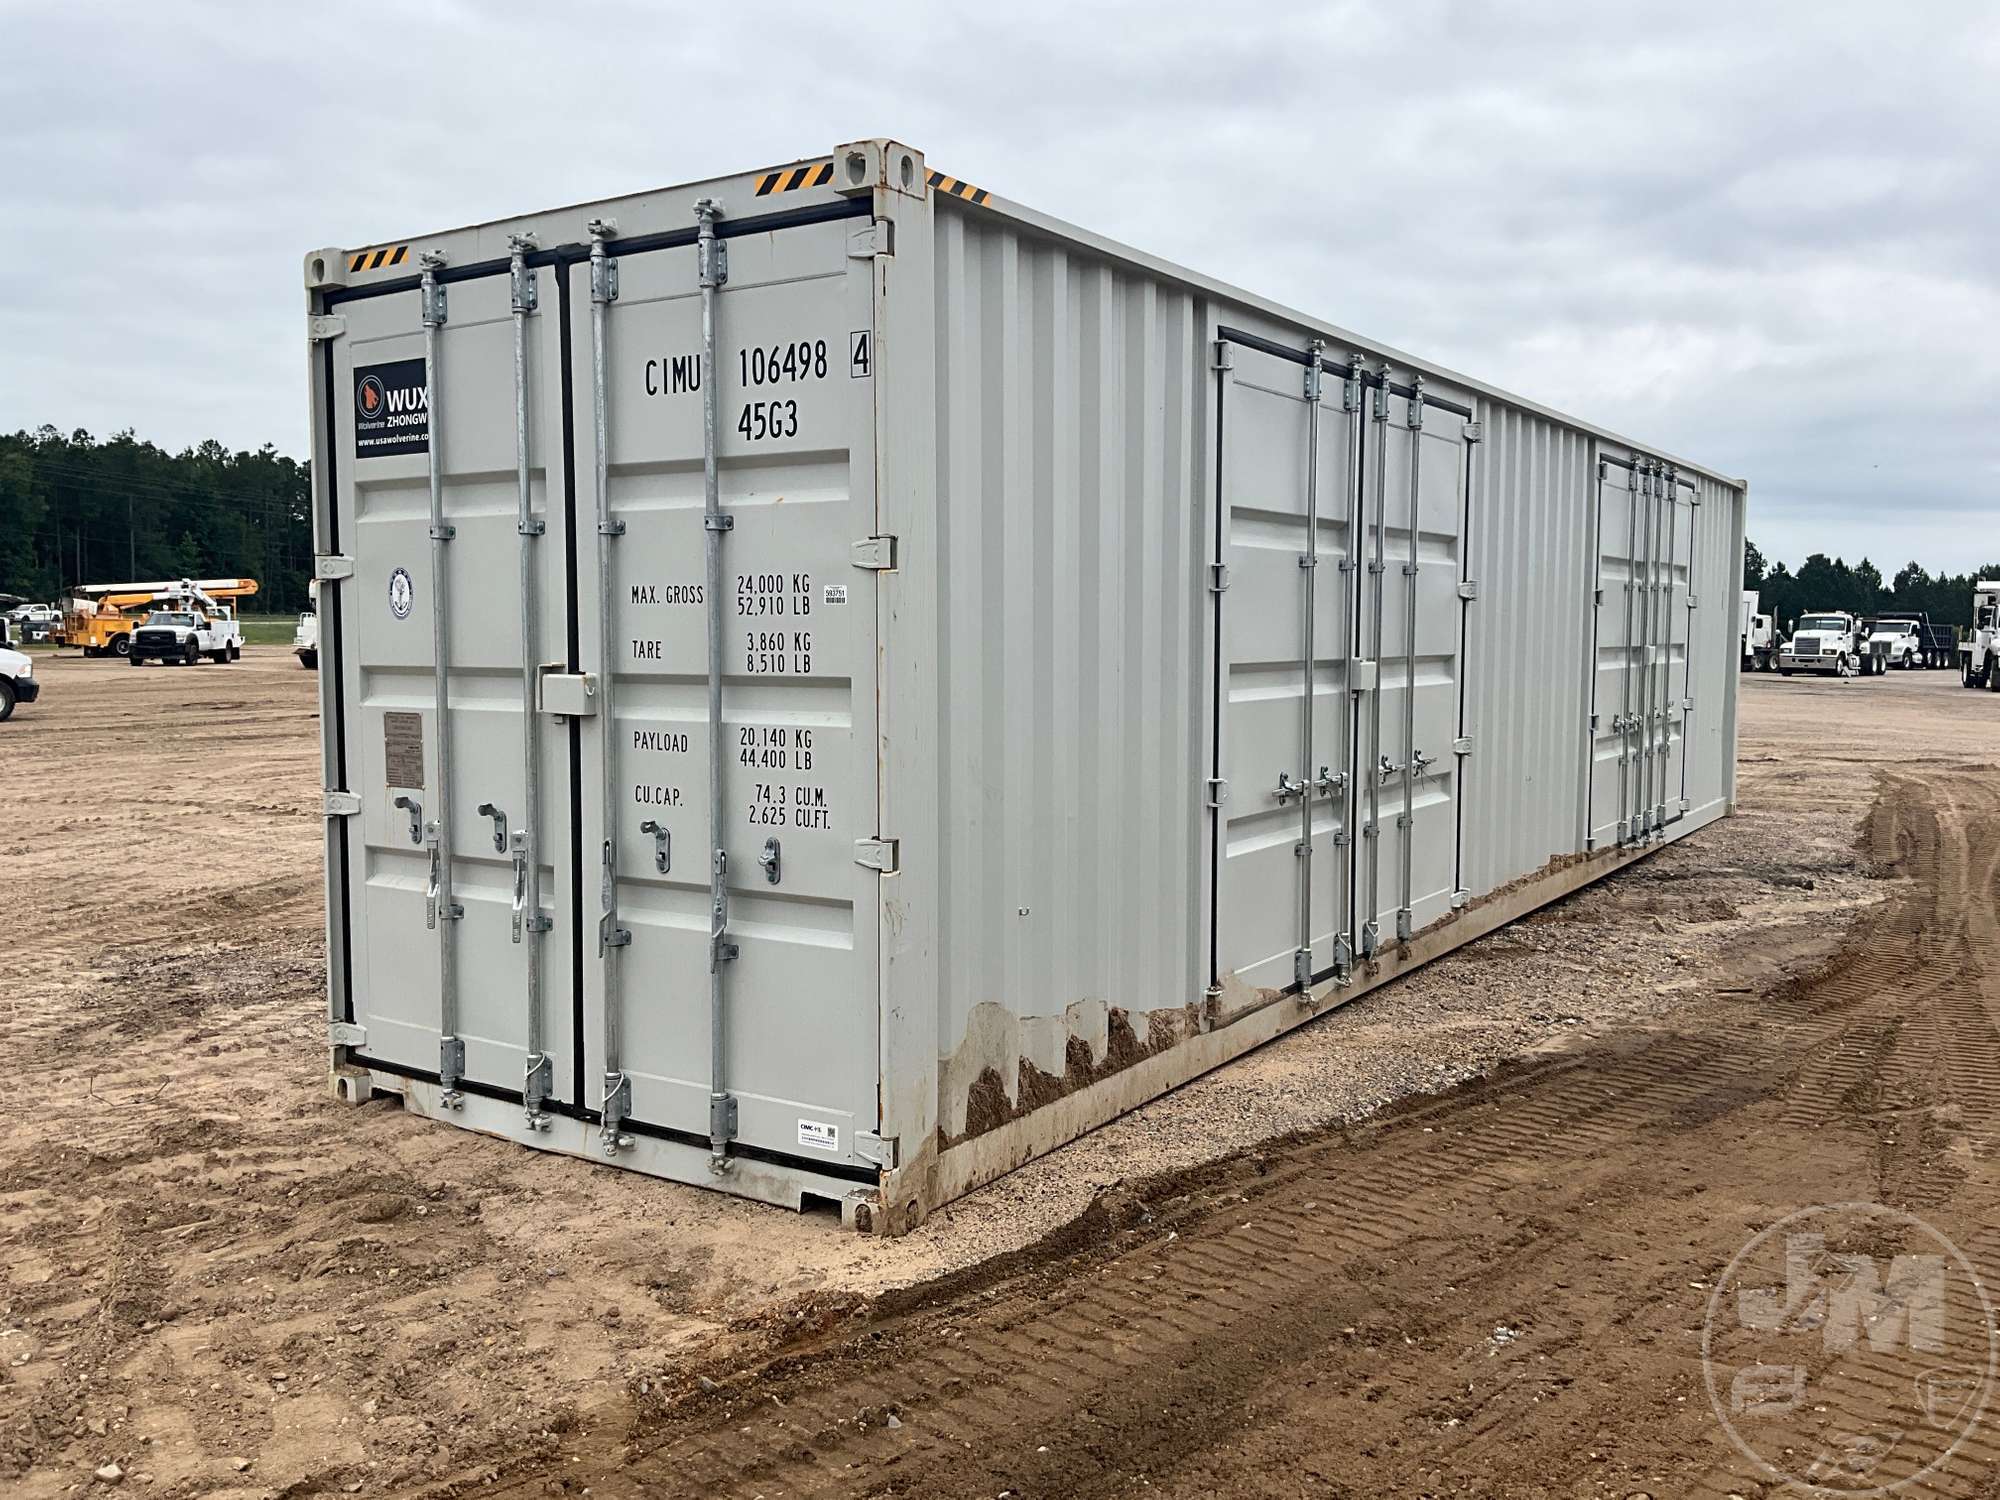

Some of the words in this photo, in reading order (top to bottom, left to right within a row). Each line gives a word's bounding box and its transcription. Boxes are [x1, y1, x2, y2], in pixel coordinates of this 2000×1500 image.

[646, 355, 700, 395] CIMU
[740, 340, 827, 387] 106498
[853, 334, 868, 374] 4
[739, 400, 797, 440] 45G3
[793, 574, 809, 593] KG
[632, 586, 659, 603] MAX.
[667, 586, 703, 603] GROSS
[794, 596, 809, 615] LB
[633, 641, 661, 659] TARE
[795, 633, 810, 651] KG
[795, 654, 810, 673] LB
[635, 731, 687, 752] PAYLOAD
[796, 730, 811, 748] KG
[796, 751, 811, 769] LB
[756, 784, 785, 804] 74.3
[796, 787, 826, 807] CU.M.
[796, 809, 830, 829] CU.FT.
